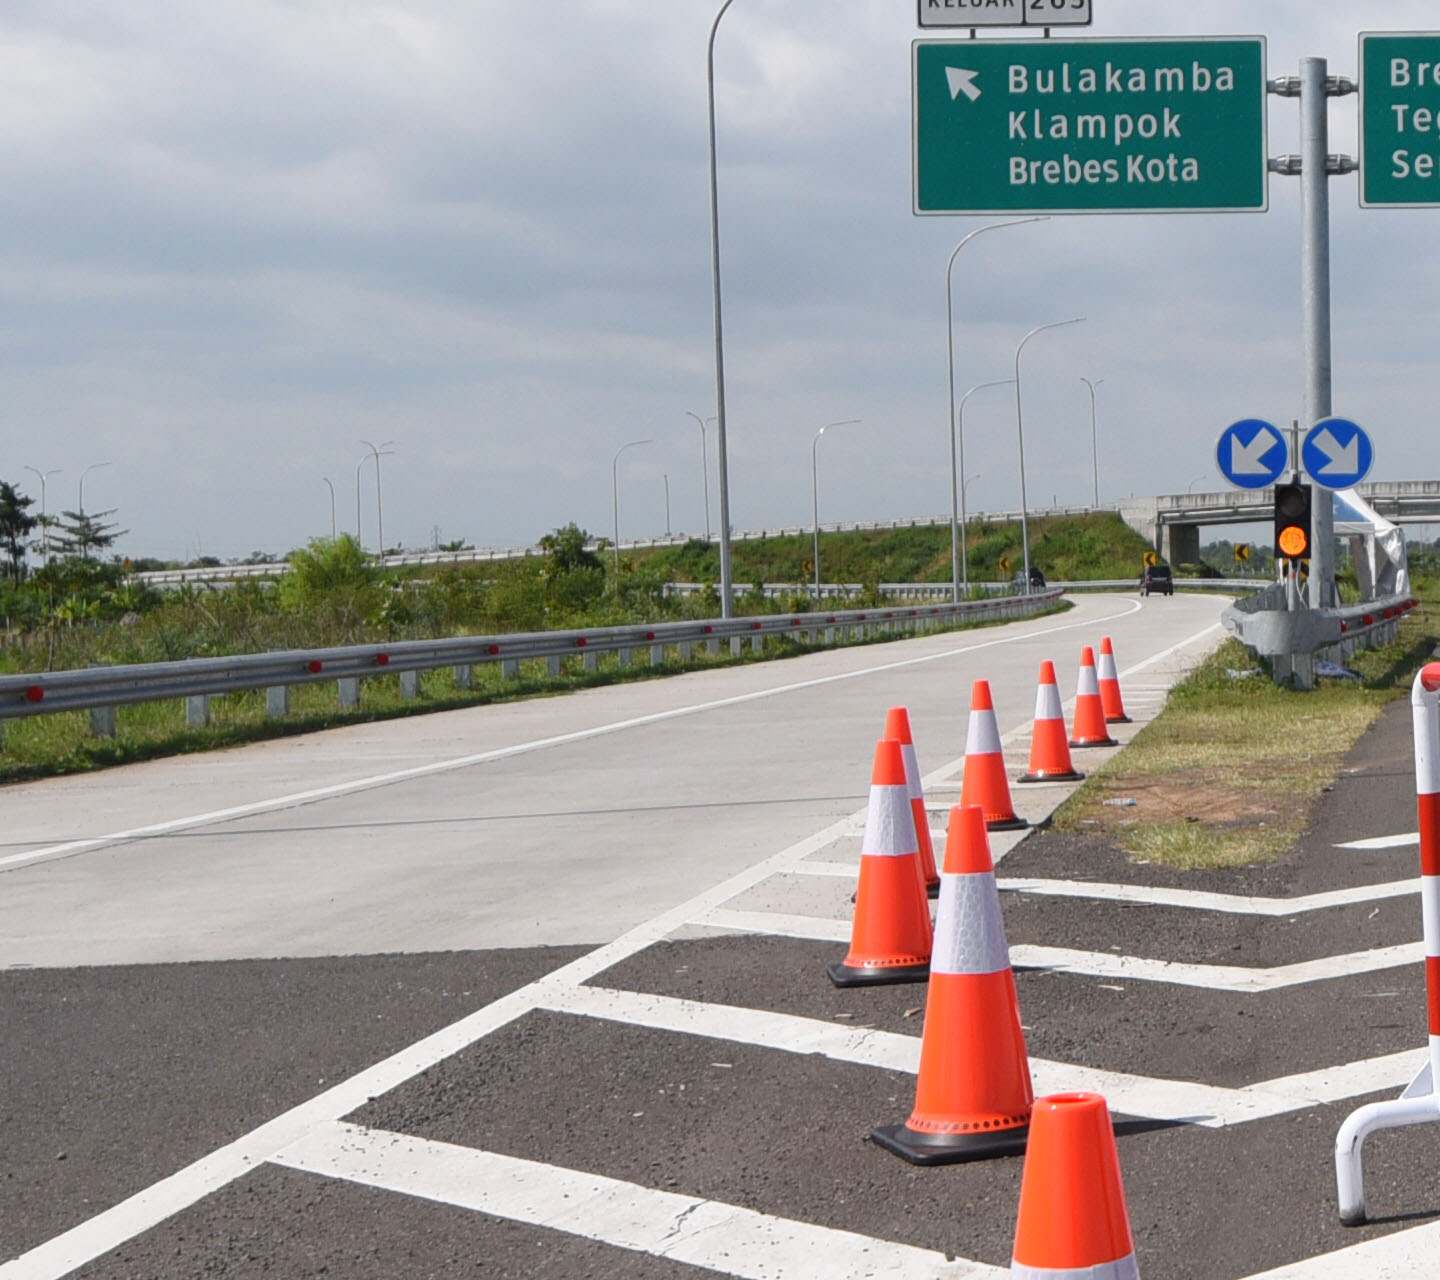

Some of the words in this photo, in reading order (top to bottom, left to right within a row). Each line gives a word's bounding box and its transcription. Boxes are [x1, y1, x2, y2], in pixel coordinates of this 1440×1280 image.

[1008, 61, 1234, 94] Bulakamba
[1008, 107, 1182, 146] Klampok
[1009, 153, 1119, 185] Brebes
[1126, 153, 1199, 183] Kota
